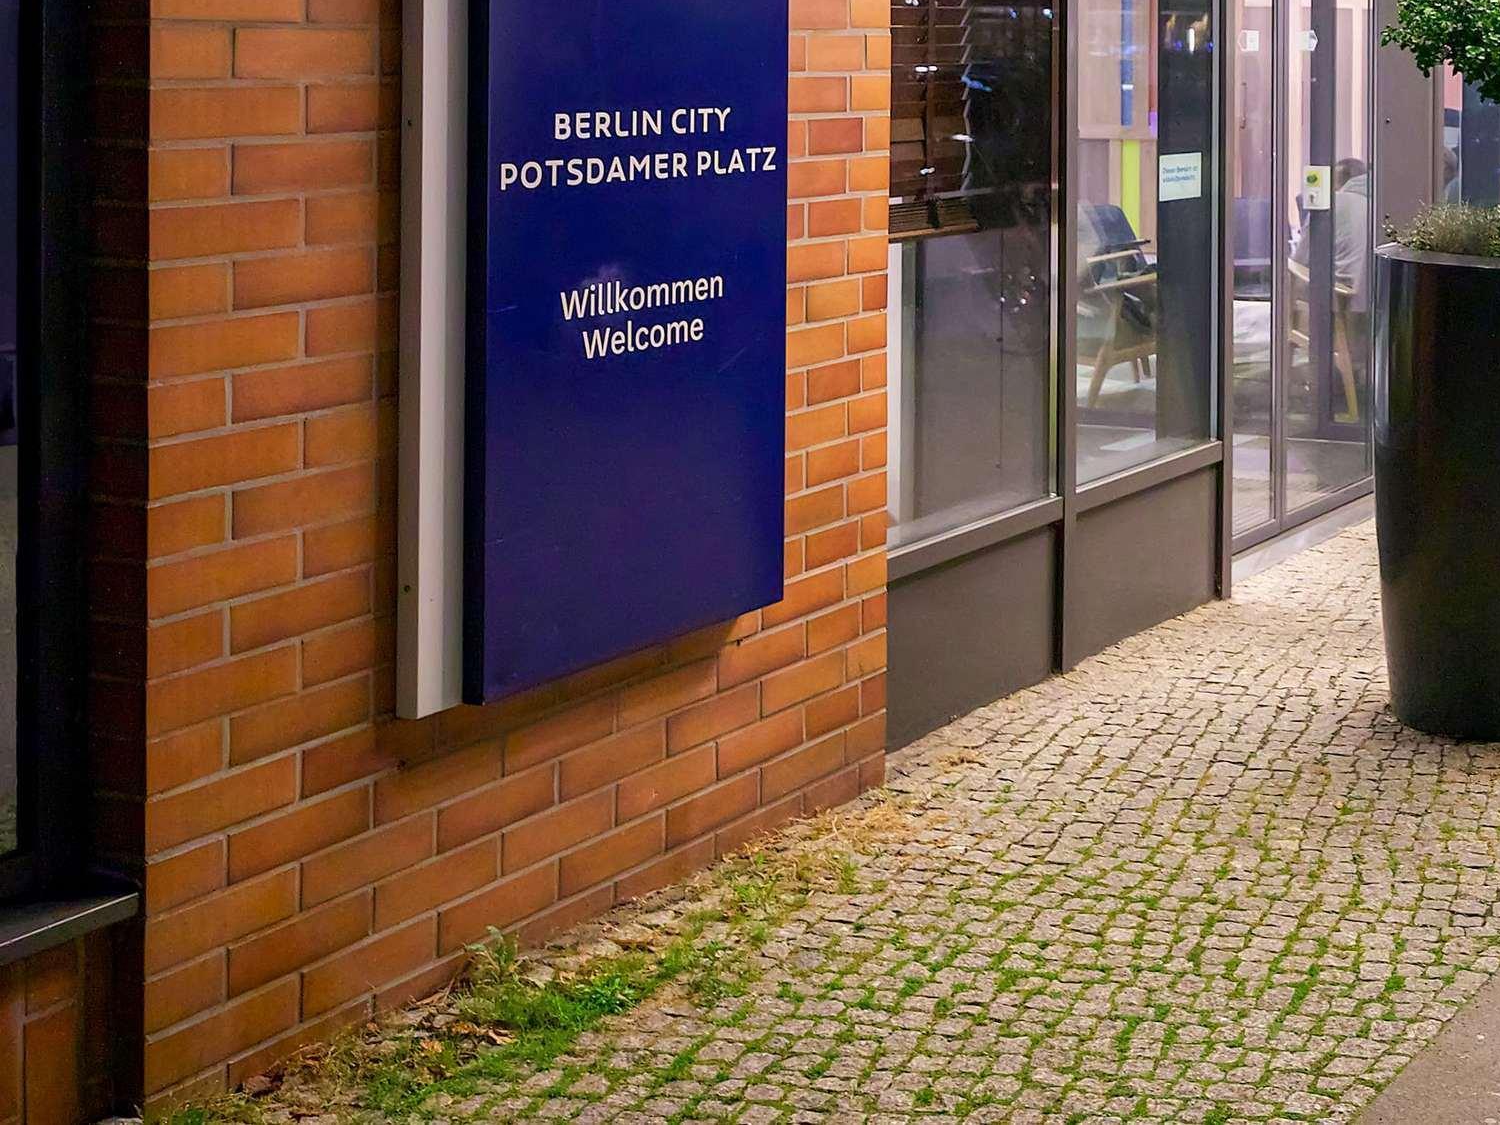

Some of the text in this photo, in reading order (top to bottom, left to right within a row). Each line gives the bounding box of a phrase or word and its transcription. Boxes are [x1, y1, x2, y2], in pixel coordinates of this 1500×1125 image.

[554, 107, 731, 140] BERLIN CITY
[500, 146, 777, 191] POTSDAMER PLATZ
[560, 275, 724, 321] Willkommen
[582, 318, 704, 360] Welcome
